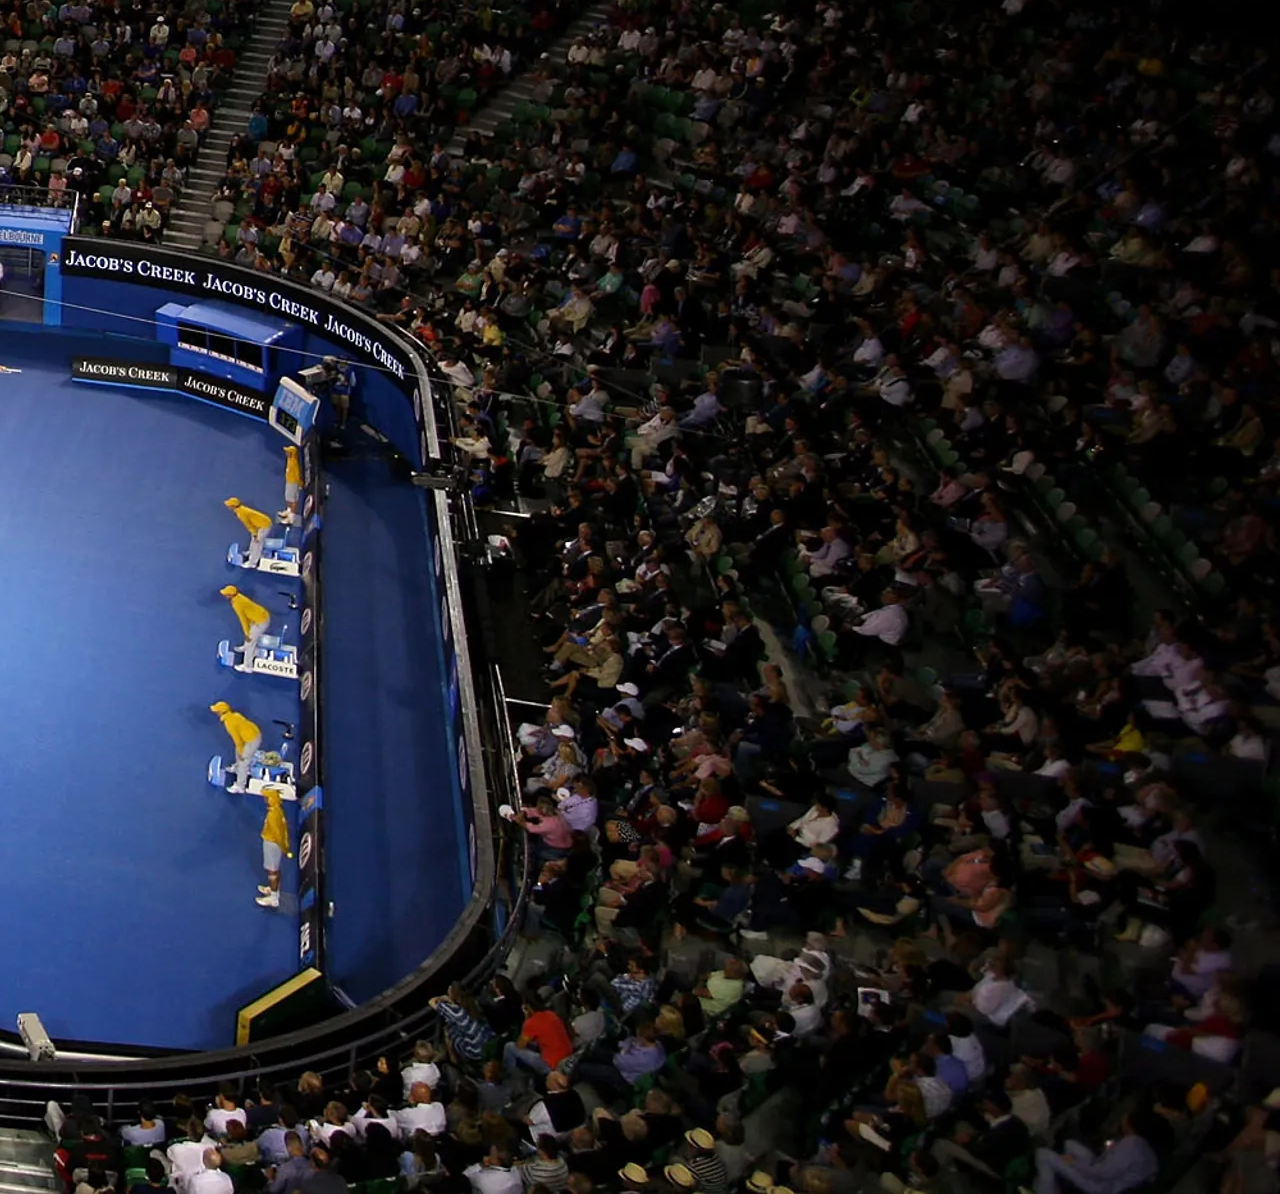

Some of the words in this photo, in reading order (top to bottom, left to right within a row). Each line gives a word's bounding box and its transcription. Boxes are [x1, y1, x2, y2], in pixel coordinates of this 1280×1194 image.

[65, 249, 133, 275] JACOB'S
[137, 260, 195, 286] CREEK
[203, 272, 266, 306] JACOB'S
[269, 292, 319, 326] CREEK
[323, 313, 372, 354] JACOB'S
[372, 340, 406, 381] CREEK
[79, 360, 127, 377] JACOB'S
[128, 365, 171, 383] CREEK
[184, 375, 227, 400] JACOB'S
[227, 389, 266, 412] CREEK
[256, 661, 295, 675] LACOSTE
